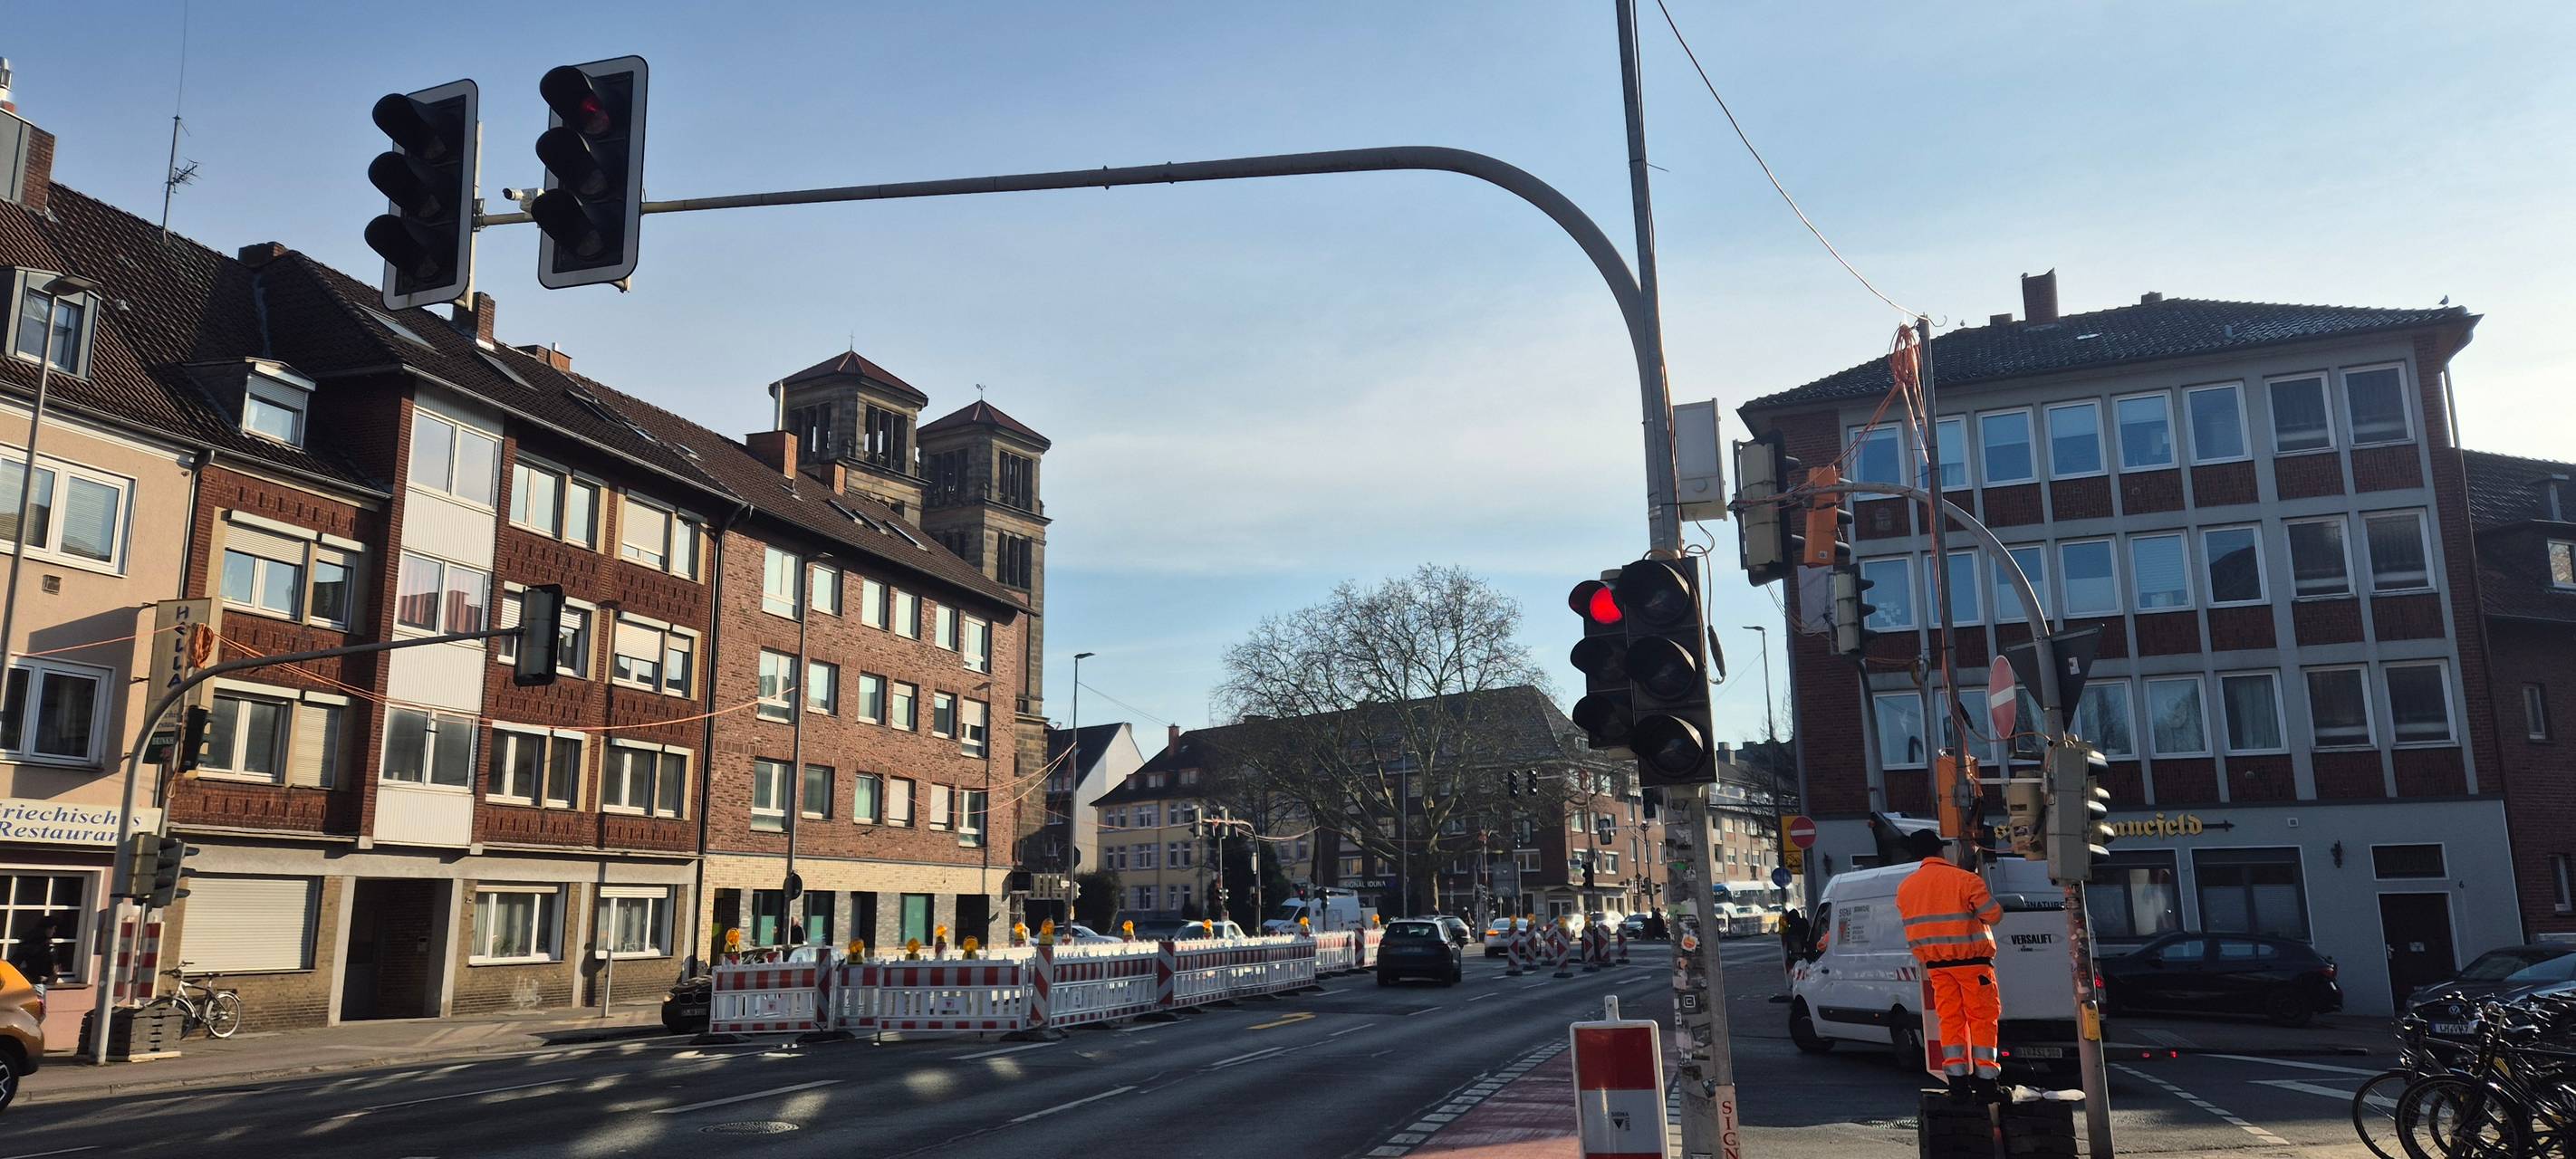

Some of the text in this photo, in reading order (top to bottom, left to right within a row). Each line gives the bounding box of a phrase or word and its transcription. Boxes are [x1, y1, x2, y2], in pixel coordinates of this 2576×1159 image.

[0, 803, 141, 827] riechischs
[2103, 812, 2204, 840] anefeld
[0, 820, 120, 843] Restauran
[2011, 934, 2052, 945] VERSALIFT
